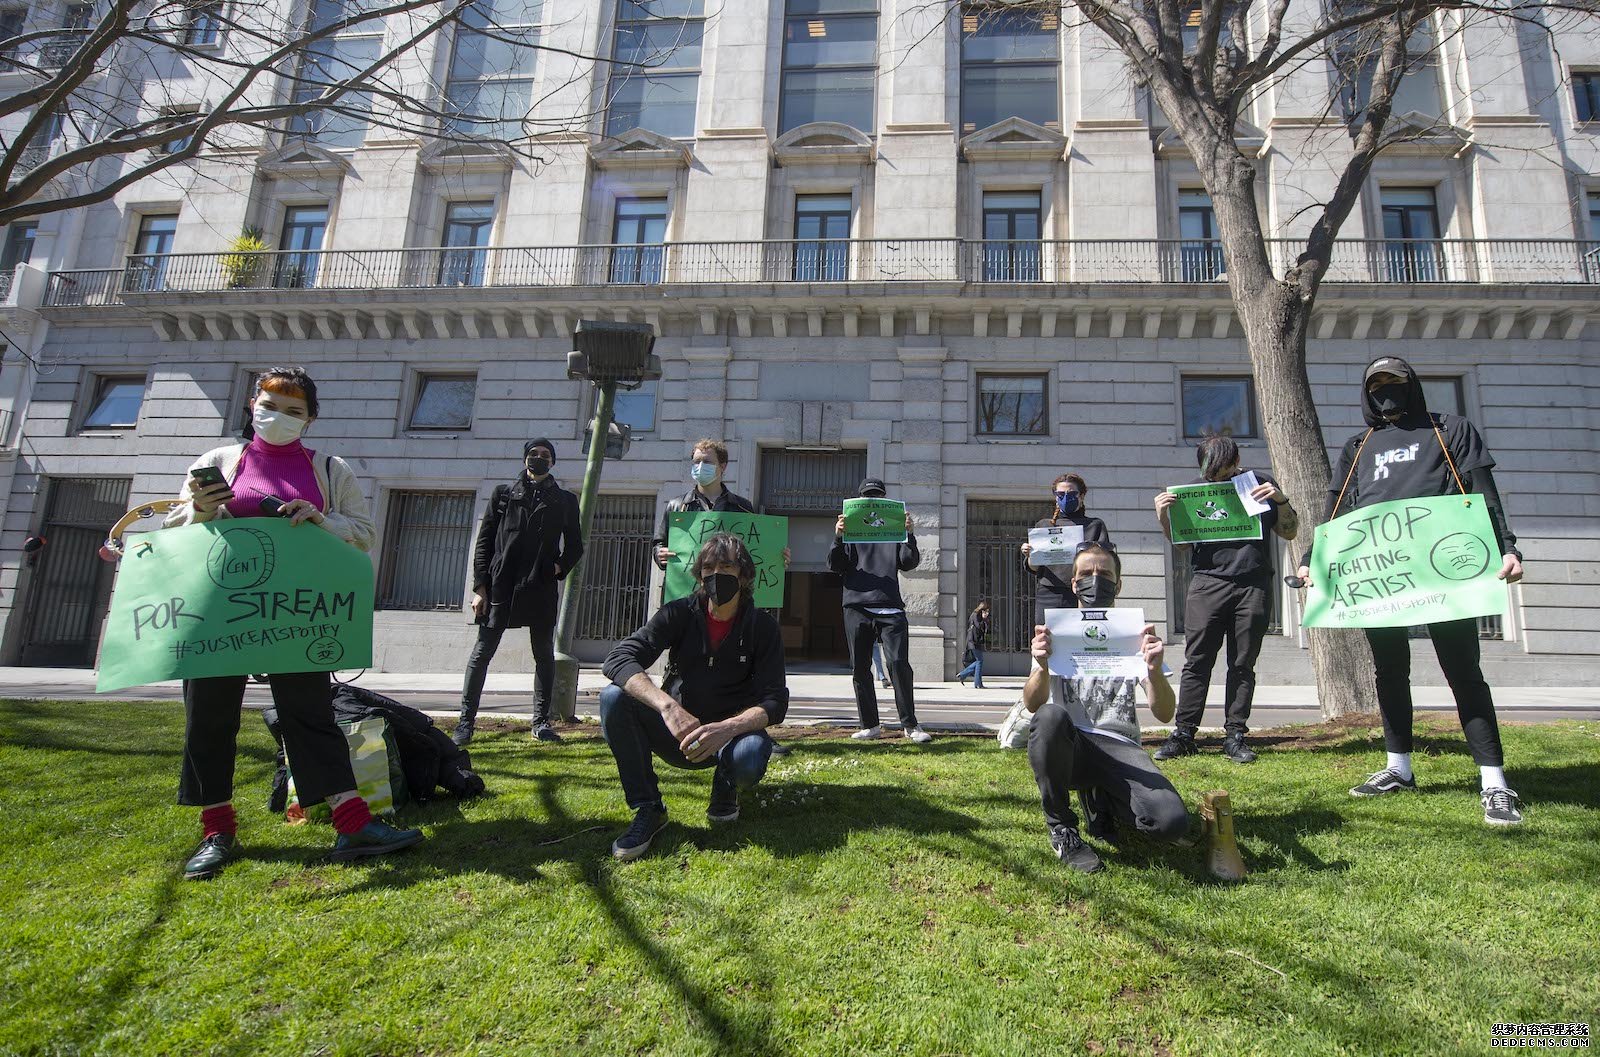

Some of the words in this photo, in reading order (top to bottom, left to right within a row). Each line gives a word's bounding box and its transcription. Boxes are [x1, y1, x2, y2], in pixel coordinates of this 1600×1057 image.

[1176, 491, 1206, 500] USTICIA
[1221, 488, 1237, 496] SPO
[1195, 525, 1253, 535] TRANSPARENTES
[1338, 506, 1432, 554] STOP
[214, 544, 227, 580] 1
[226, 556, 260, 574] CENT
[1328, 549, 1411, 579] FIGHTING
[1330, 572, 1417, 609] ARTIST
[133, 597, 205, 641] POR
[226, 588, 355, 624] STREAM
[168, 623, 340, 660] #JUSTICEATSPOTIFY
